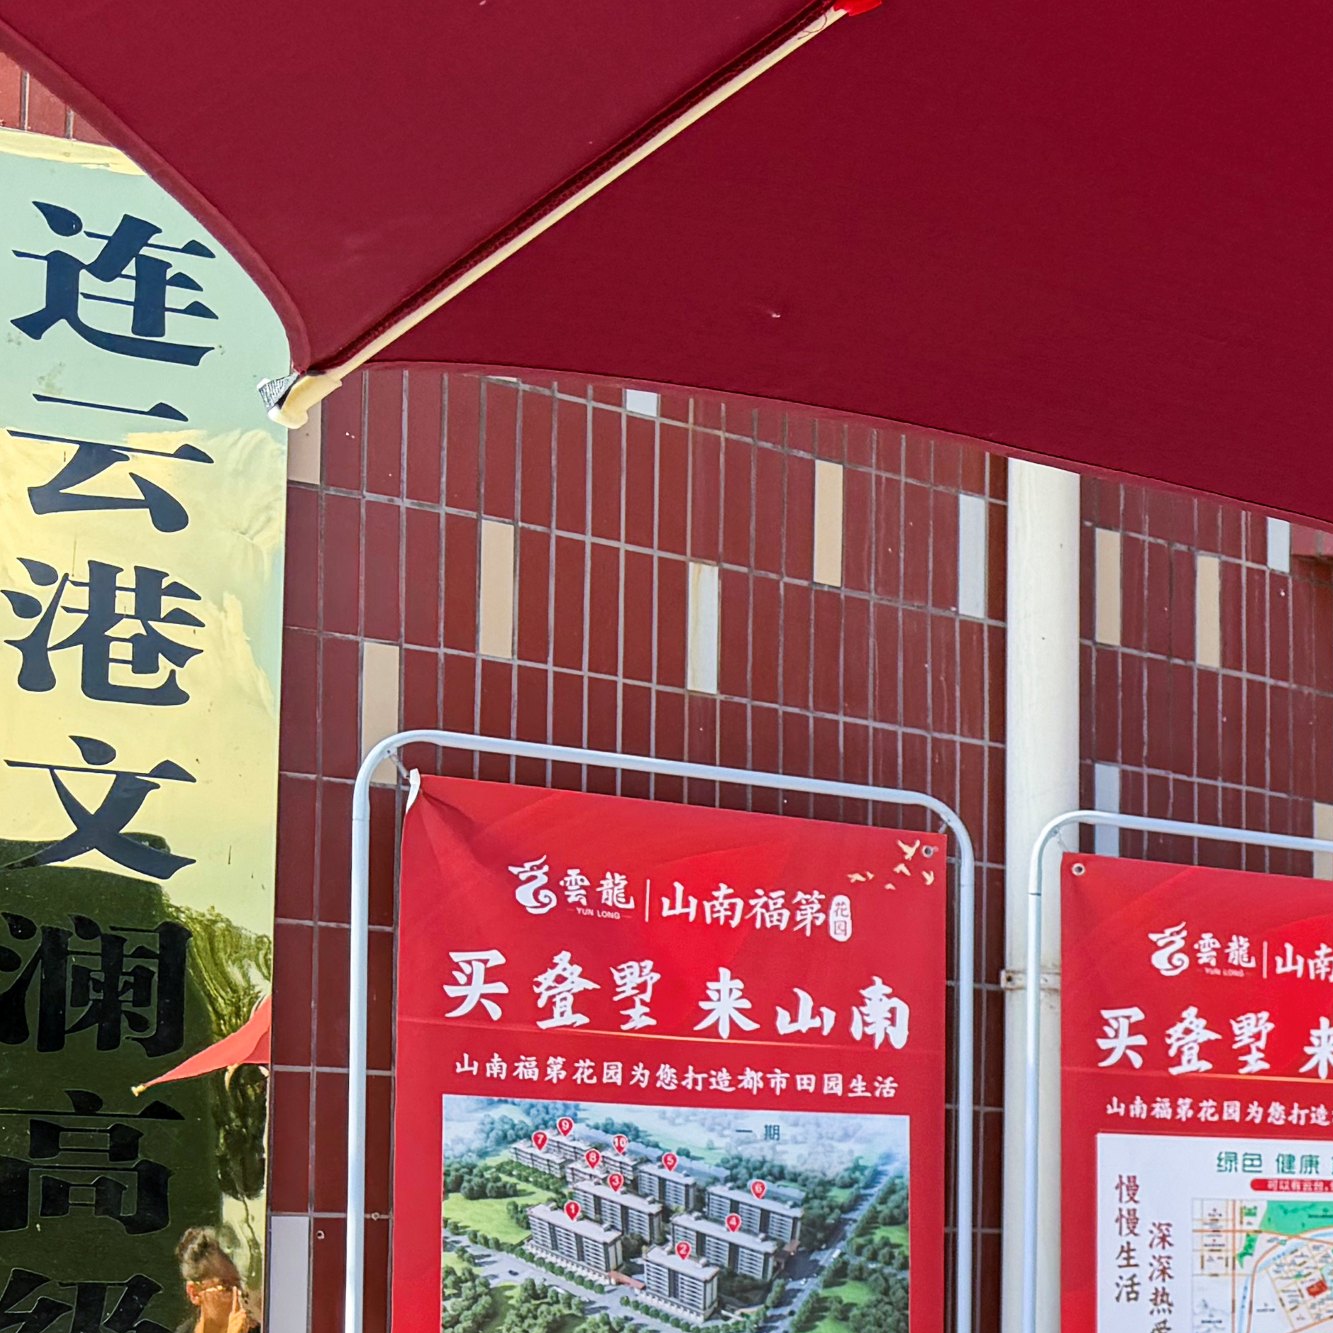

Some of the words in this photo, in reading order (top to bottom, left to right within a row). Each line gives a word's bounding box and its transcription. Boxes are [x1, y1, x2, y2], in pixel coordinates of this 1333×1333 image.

[558, 868, 635, 909] 雲龍
[661, 881, 828, 938] 山南福第
[576, 907, 594, 918] YUN
[596, 908, 621, 920] LONG
[1193, 933, 1256, 968] 雲龍
[442, 949, 661, 1032] 买叠墅
[693, 966, 911, 1051] 来山南
[1096, 1005, 1275, 1077] 买叠墅
[455, 1053, 899, 1098] 山南福第花园为您打造都市田园生活
[1216, 1151, 1263, 1174] 绿色
[1275, 1153, 1319, 1175] 健康
[1115, 1174, 1141, 1303] 慢慢生活
